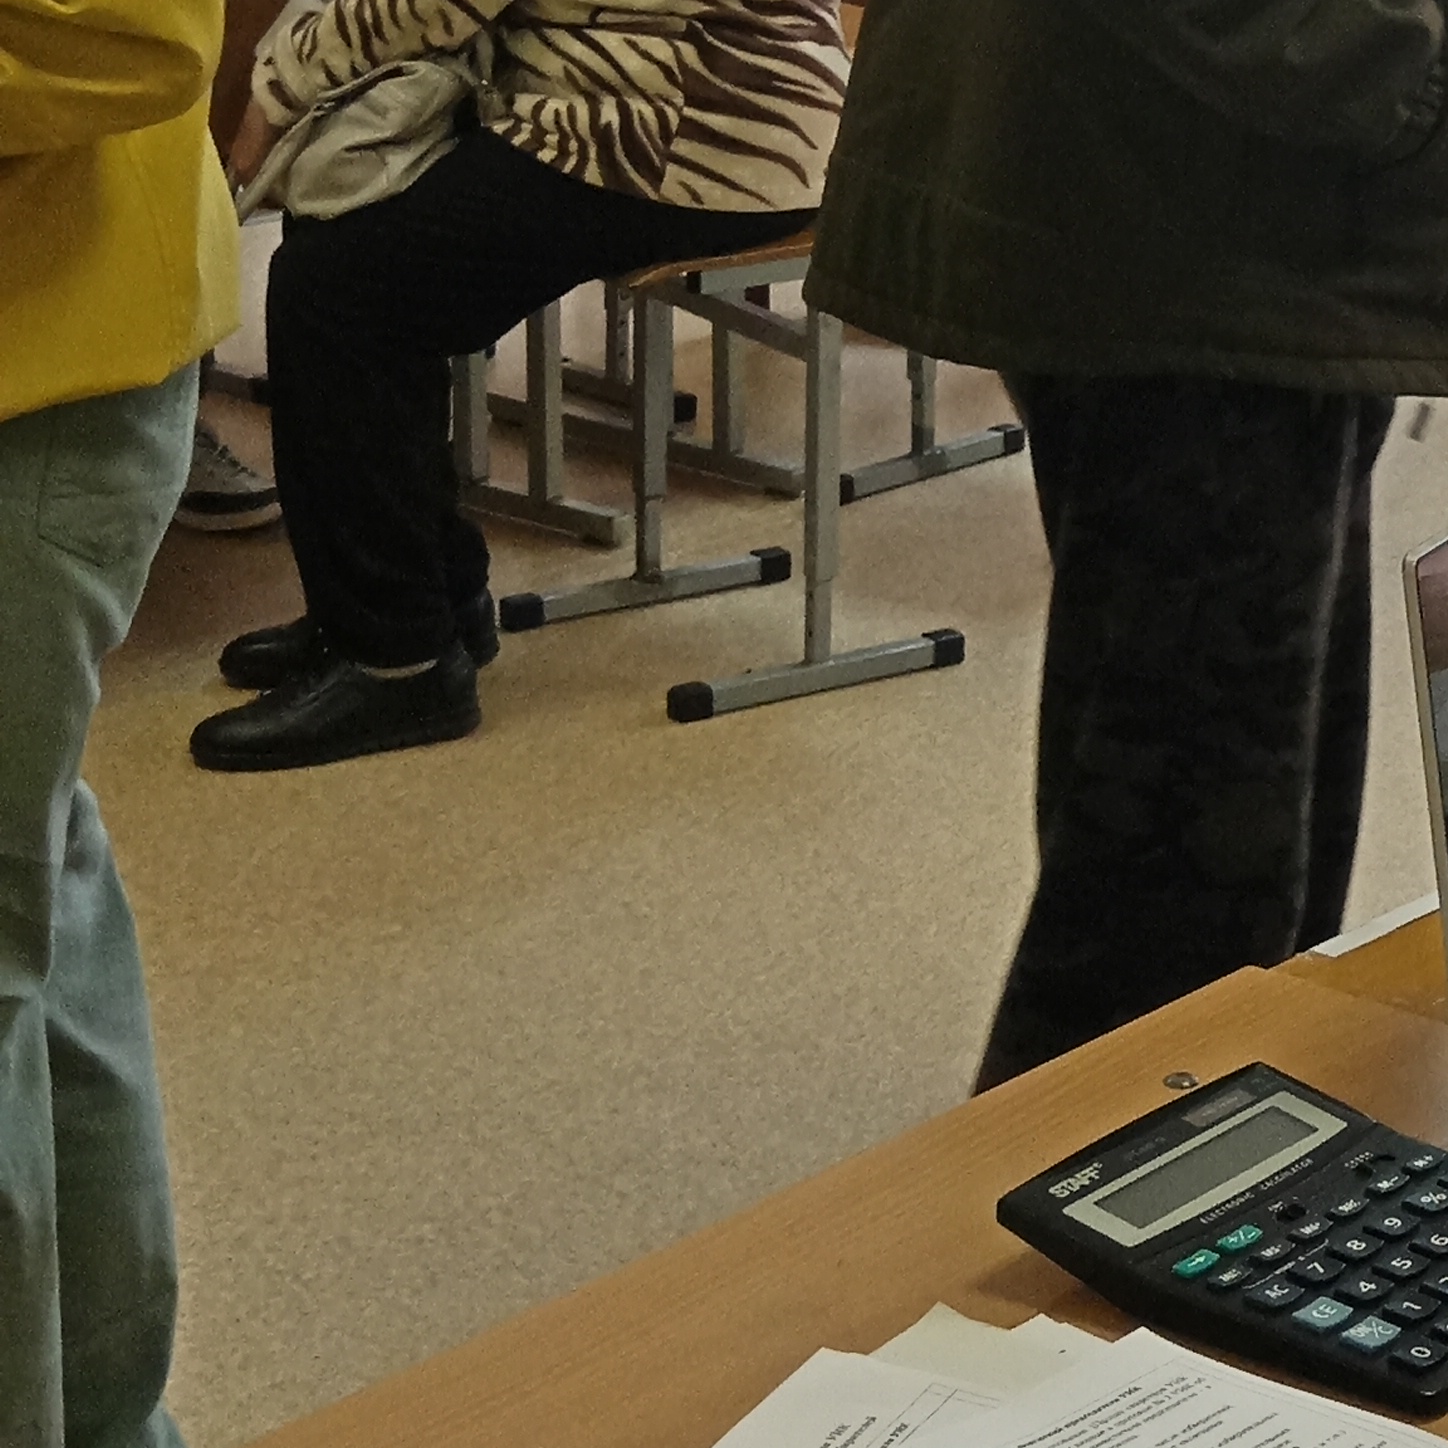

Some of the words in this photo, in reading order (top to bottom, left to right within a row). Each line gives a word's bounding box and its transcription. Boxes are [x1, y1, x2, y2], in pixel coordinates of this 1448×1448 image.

[1049, 1164, 1102, 1199] STAFF
[1200, 1192, 1255, 1225] ELECTRONIC
[1264, 1283, 1290, 1299] AC
[1307, 1261, 1325, 1274] 7
[1346, 1239, 1367, 1251] 8
[1384, 1217, 1403, 1230] 9
[1312, 1304, 1338, 1319] CE
[1358, 1280, 1377, 1293] 4
[1391, 1257, 1413, 1270] 5
[1402, 1301, 1422, 1312] 1
[1410, 1346, 1431, 1359] 0
